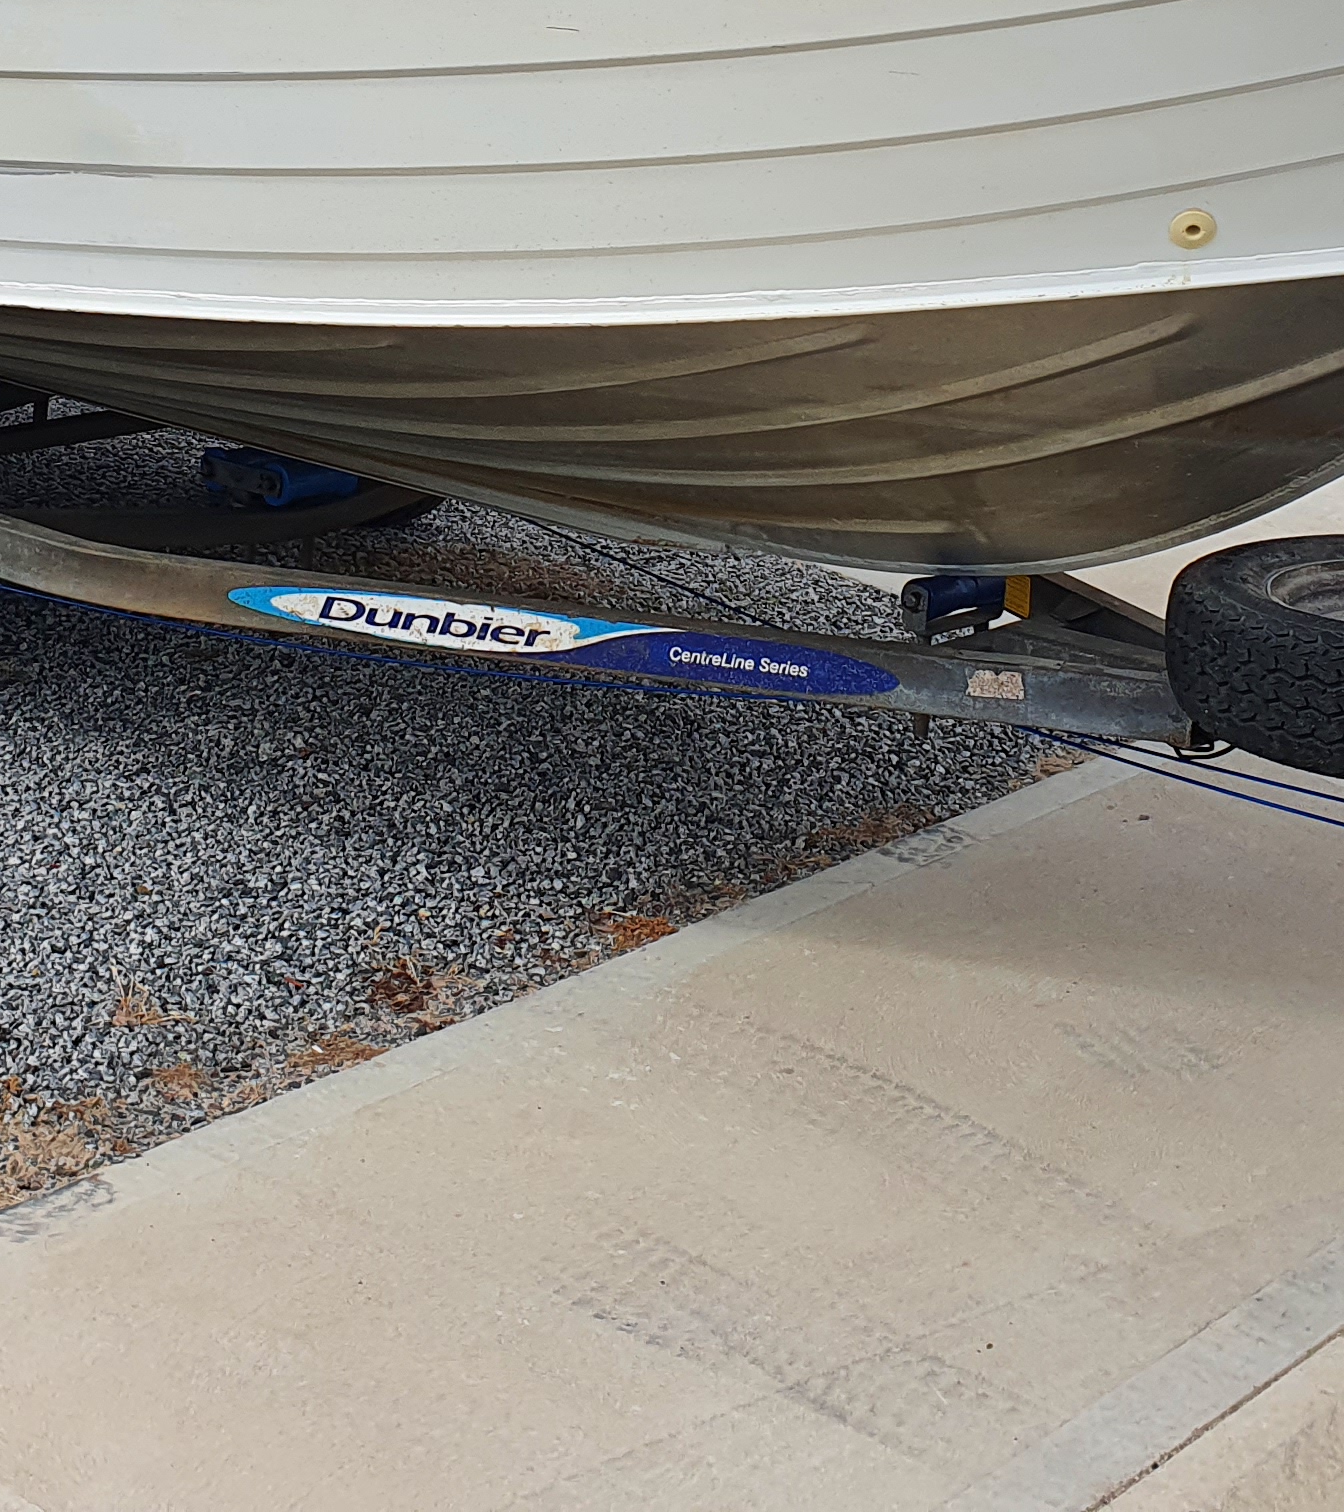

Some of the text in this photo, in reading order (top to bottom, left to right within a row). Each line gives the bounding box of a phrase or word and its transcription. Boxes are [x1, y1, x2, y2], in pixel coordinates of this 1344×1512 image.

[319, 595, 551, 648] Dunbier
[669, 645, 809, 678] CentreLine Series
